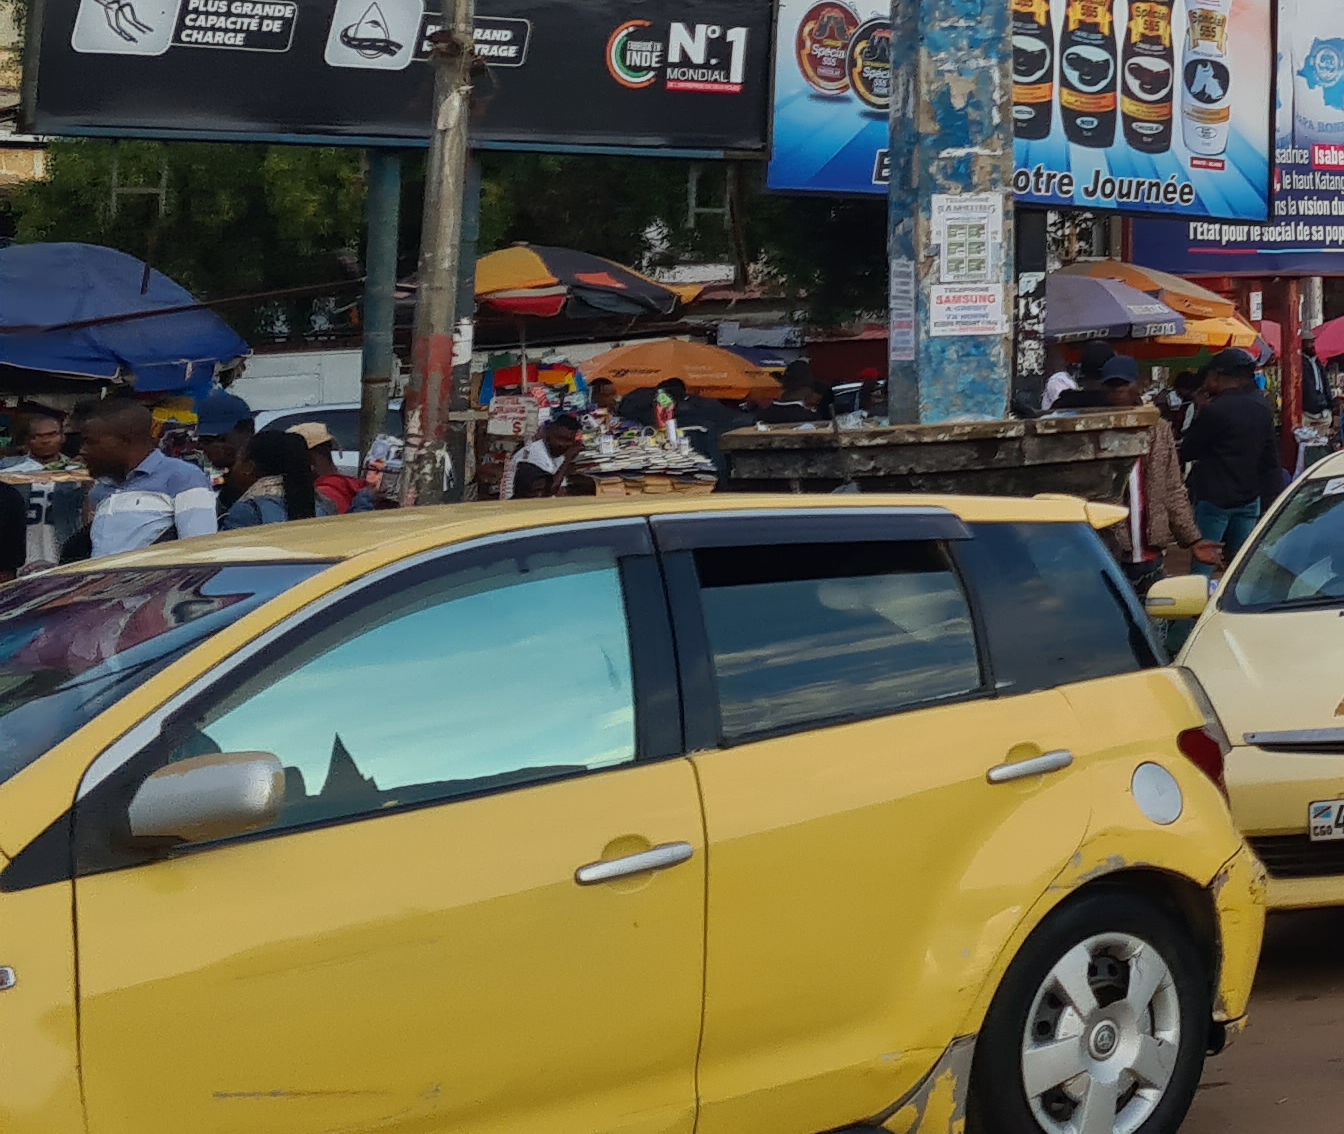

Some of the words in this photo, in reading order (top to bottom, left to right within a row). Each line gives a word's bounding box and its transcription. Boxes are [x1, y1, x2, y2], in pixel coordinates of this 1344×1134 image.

[230, 1, 295, 18] GRANDE
[1080, 4, 1099, 19] 555
[184, 14, 260, 31] CAPACITÉ
[261, 19, 283, 33] DE
[181, 29, 247, 46] CHARGE
[625, 50, 664, 68] INDE
[666, 67, 731, 83] MONDIAL
[1275, 147, 1310, 165] sadrice
[1012, 167, 1075, 197] otre
[1084, 169, 1196, 206] Journée
[1282, 170, 1292, 191] le
[1292, 171, 1314, 191] haut
[1288, 197, 1298, 215] la
[1298, 196, 1331, 217] vision
[1332, 197, 1344, 216] du
[1222, 225, 1250, 246] pour
[1250, 223, 1262, 242] le
[1262, 221, 1296, 242] social
[1297, 221, 1310, 242] de
[1311, 225, 1324, 242] sa
[935, 293, 997, 305] SAMSUNG
[1053, 328, 1110, 344] TECNO
[1141, 322, 1177, 336] TECNO
